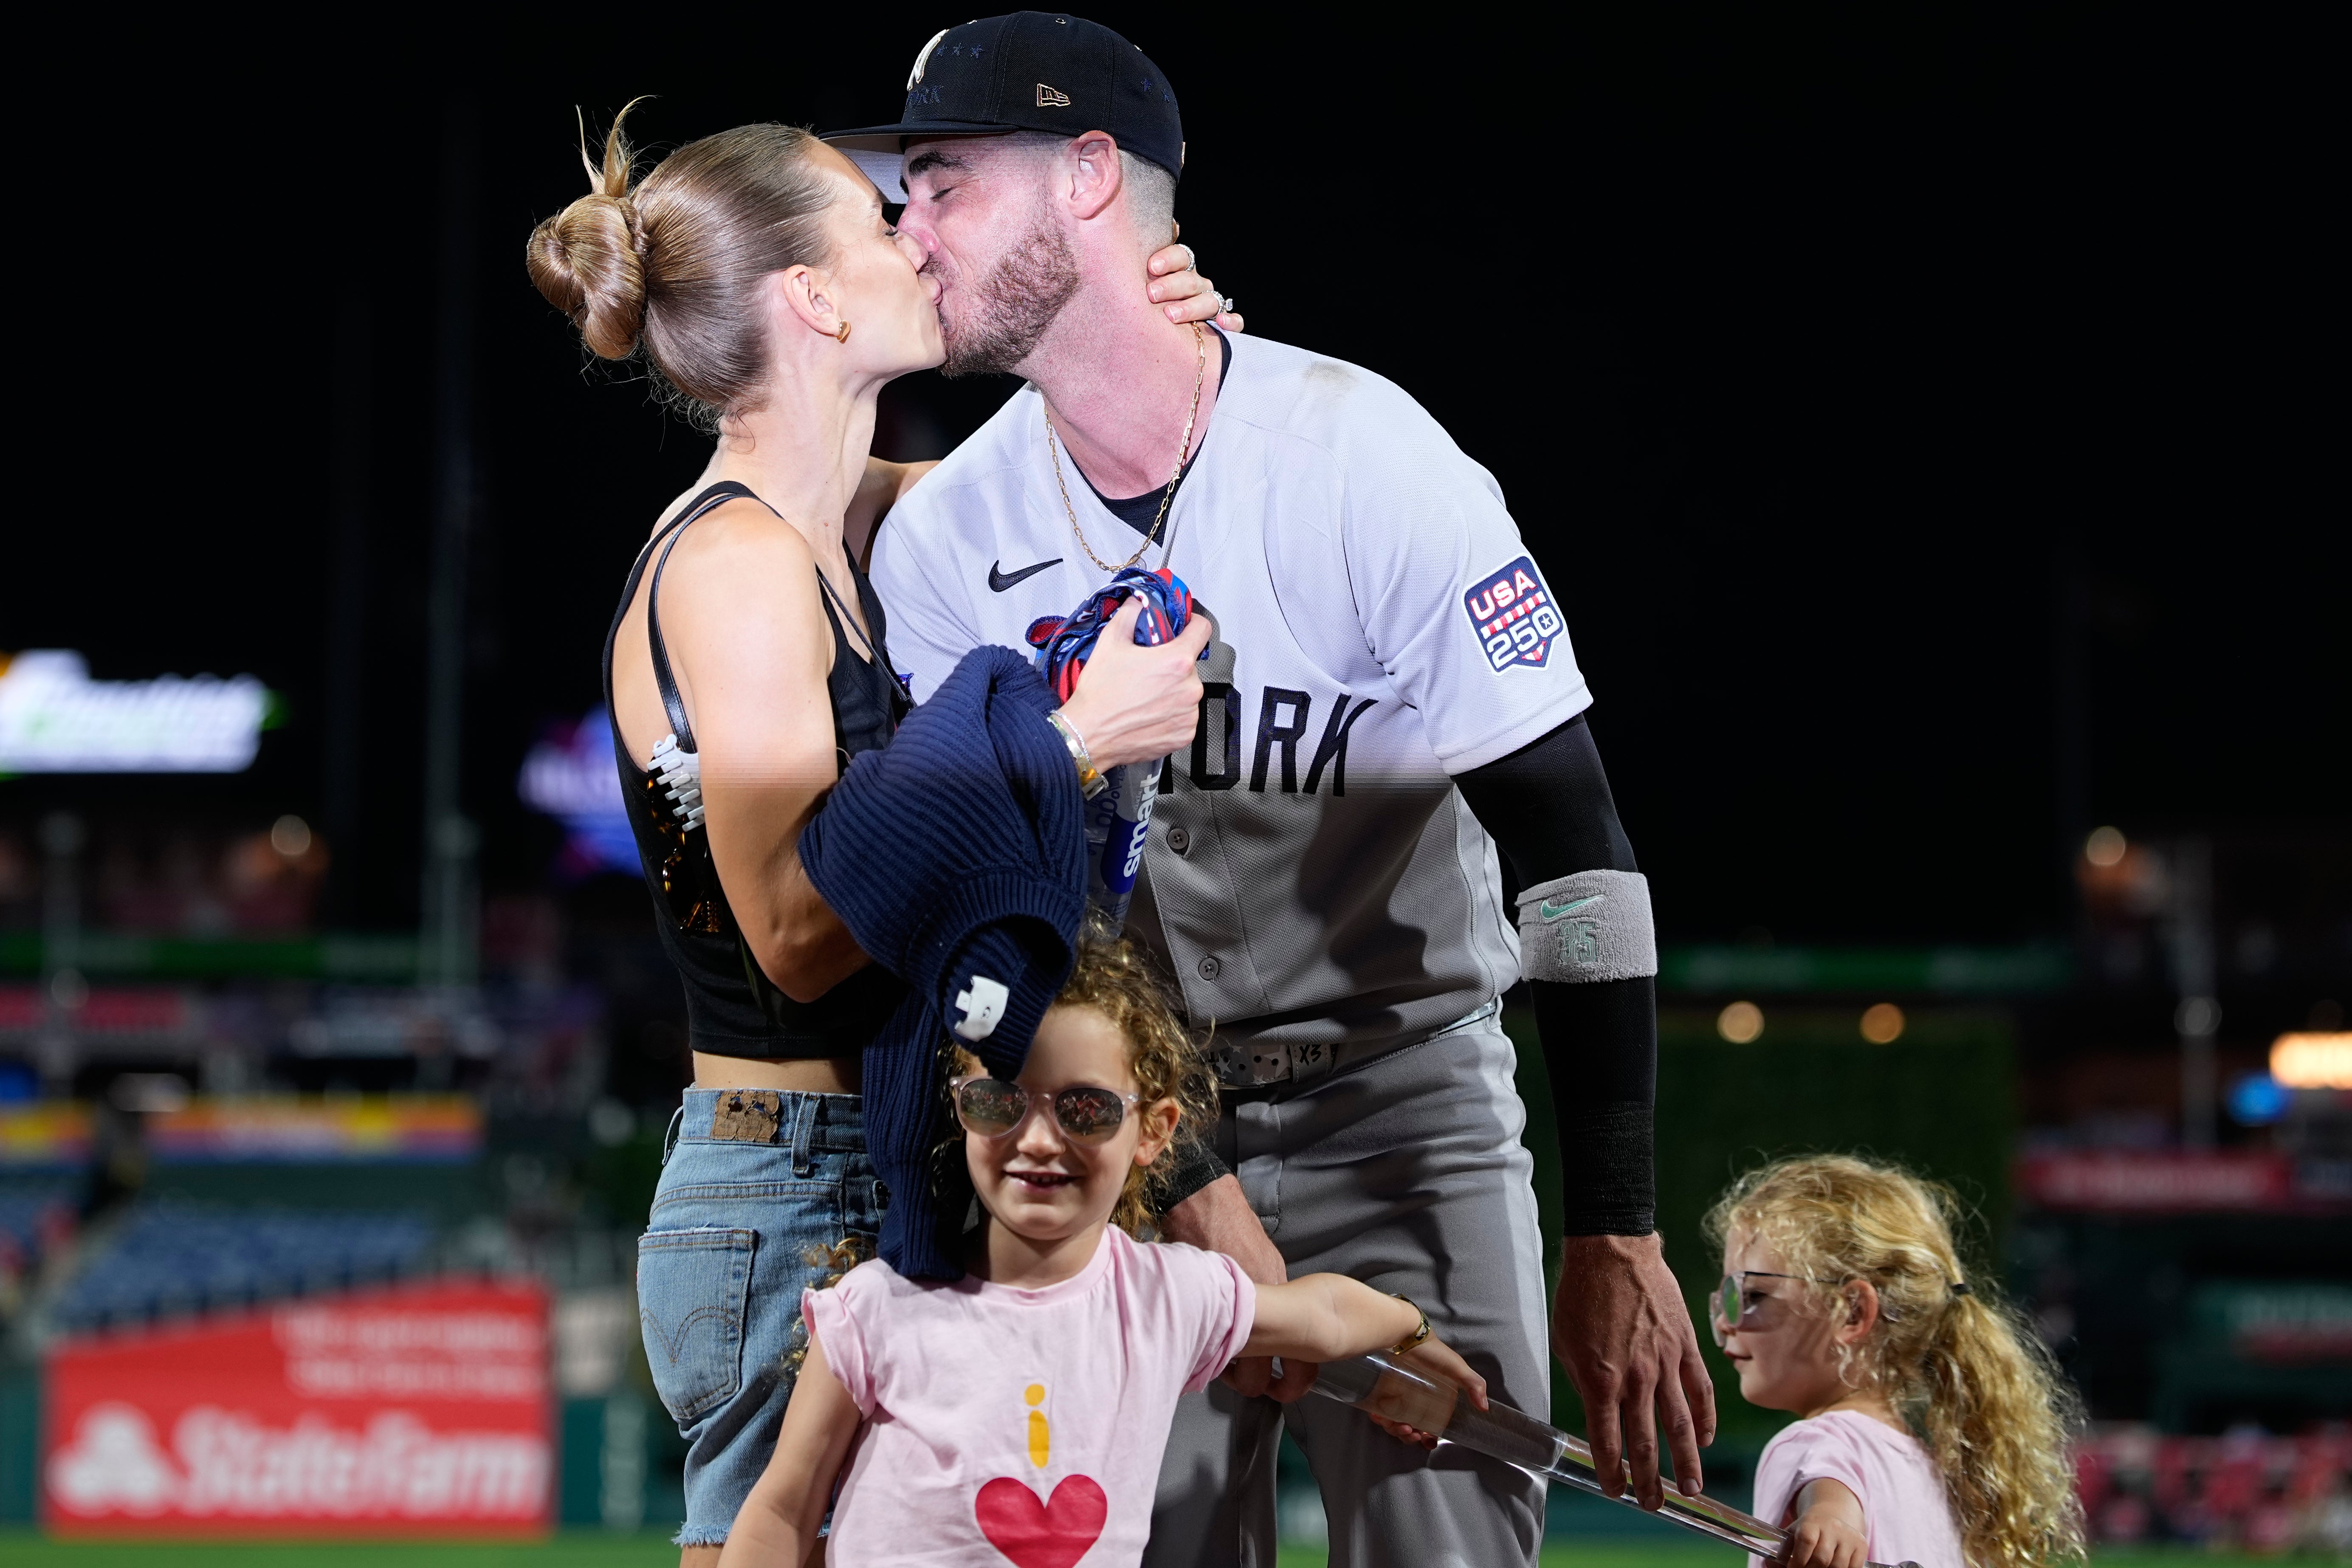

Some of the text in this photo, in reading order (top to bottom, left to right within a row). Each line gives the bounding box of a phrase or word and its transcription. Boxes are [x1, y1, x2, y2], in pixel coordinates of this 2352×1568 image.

[1469, 569, 1537, 621] USA
[1487, 606, 1560, 668] 250
[1124, 767, 1164, 877] smart
[1559, 922, 1596, 963] 35
